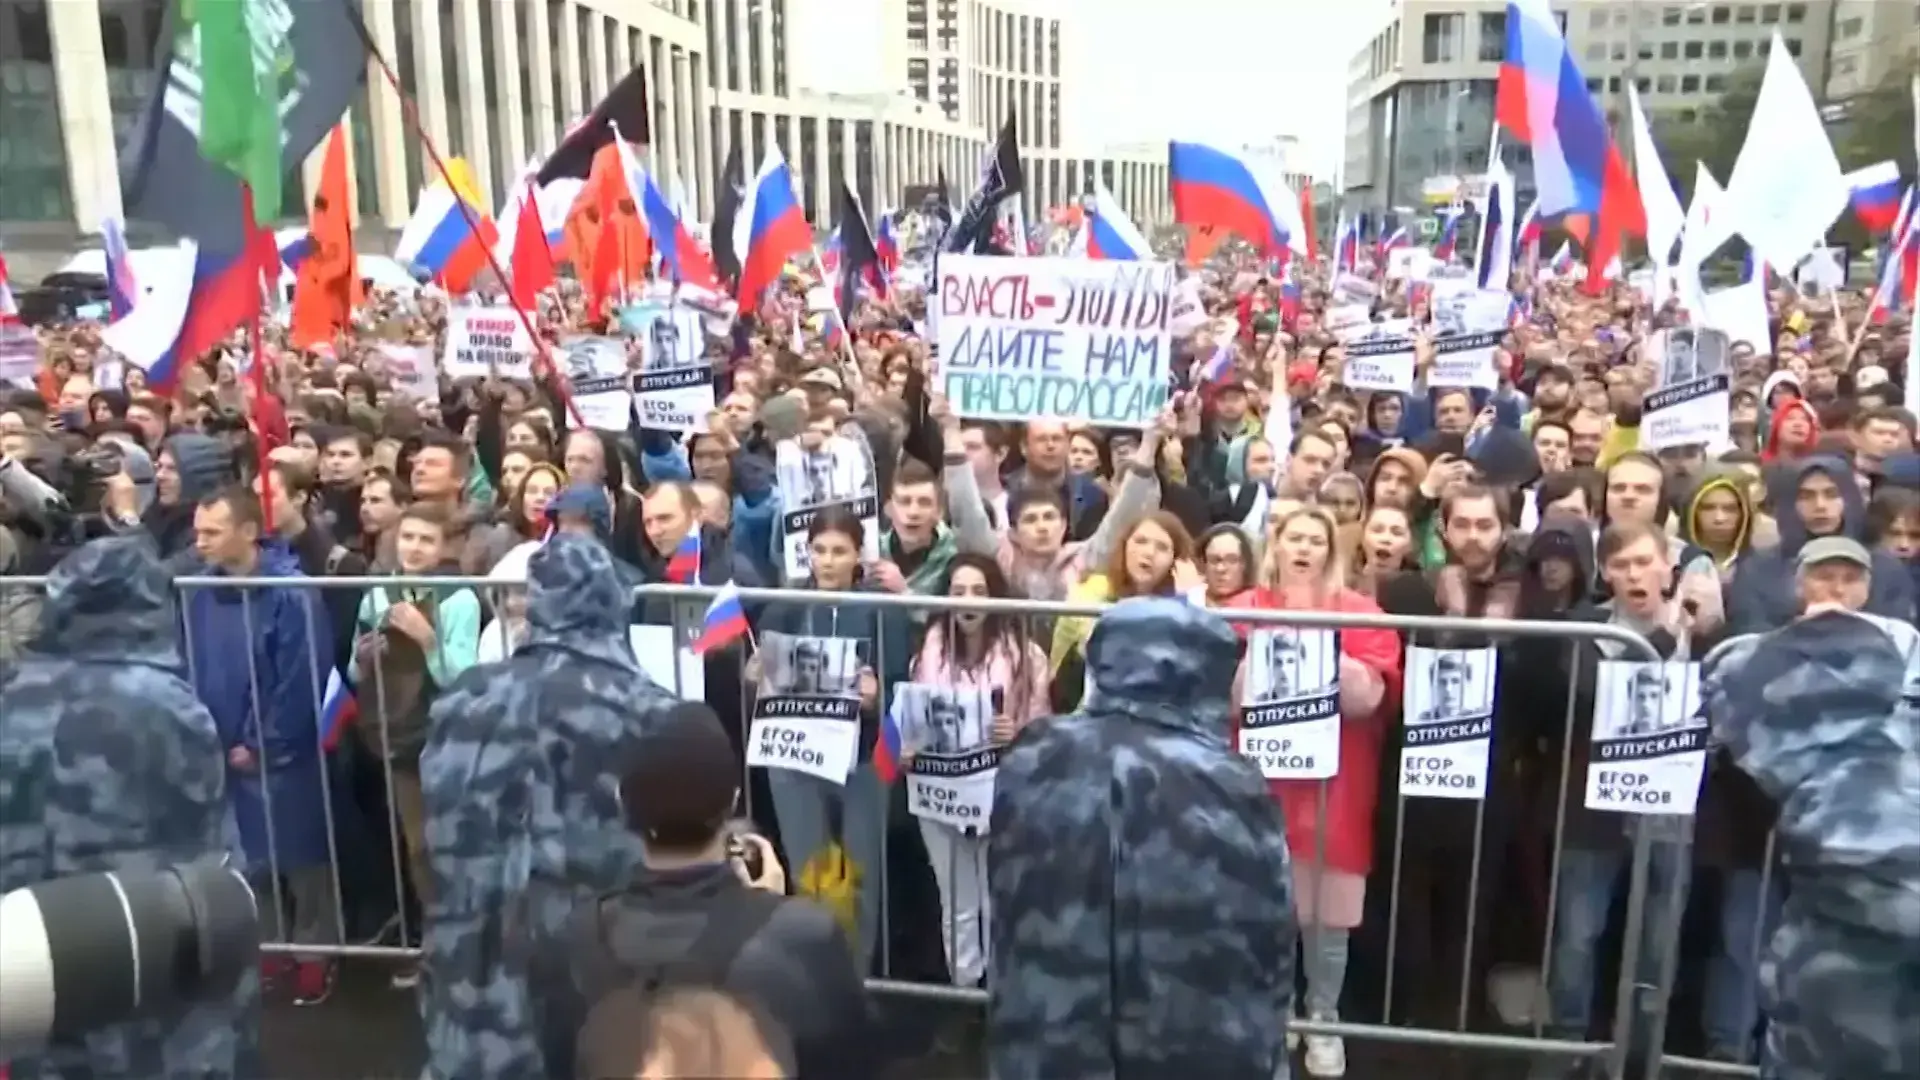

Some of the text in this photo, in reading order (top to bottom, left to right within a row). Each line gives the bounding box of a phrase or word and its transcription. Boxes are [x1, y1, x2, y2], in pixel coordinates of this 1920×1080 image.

[470, 333, 512, 349] ПРАВО
[948, 325, 1159, 378] ДАЙТЕ НАМ
[643, 400, 676, 412] ЕГОР
[765, 700, 849, 715] ОТПУСКАЙ!
[1246, 699, 1334, 724] ОТПУСКАЙ!
[762, 726, 806, 744] ЕГОР
[1246, 738, 1291, 753] ЕГОР
[1601, 733, 1696, 757] ОТПУСКАЙ!
[759, 742, 824, 766] ЖУКОВ
[916, 752, 996, 772] ОТПУСКАЙ!
[1406, 756, 1453, 770] ЕГОР
[1404, 772, 1476, 788] ЖУКОВ
[1600, 771, 1648, 786] ЕГОР
[917, 782, 958, 801] ЕГОР
[1598, 786, 1671, 804] ЖУКОВ
[918, 800, 981, 817] ЖУКОВ
